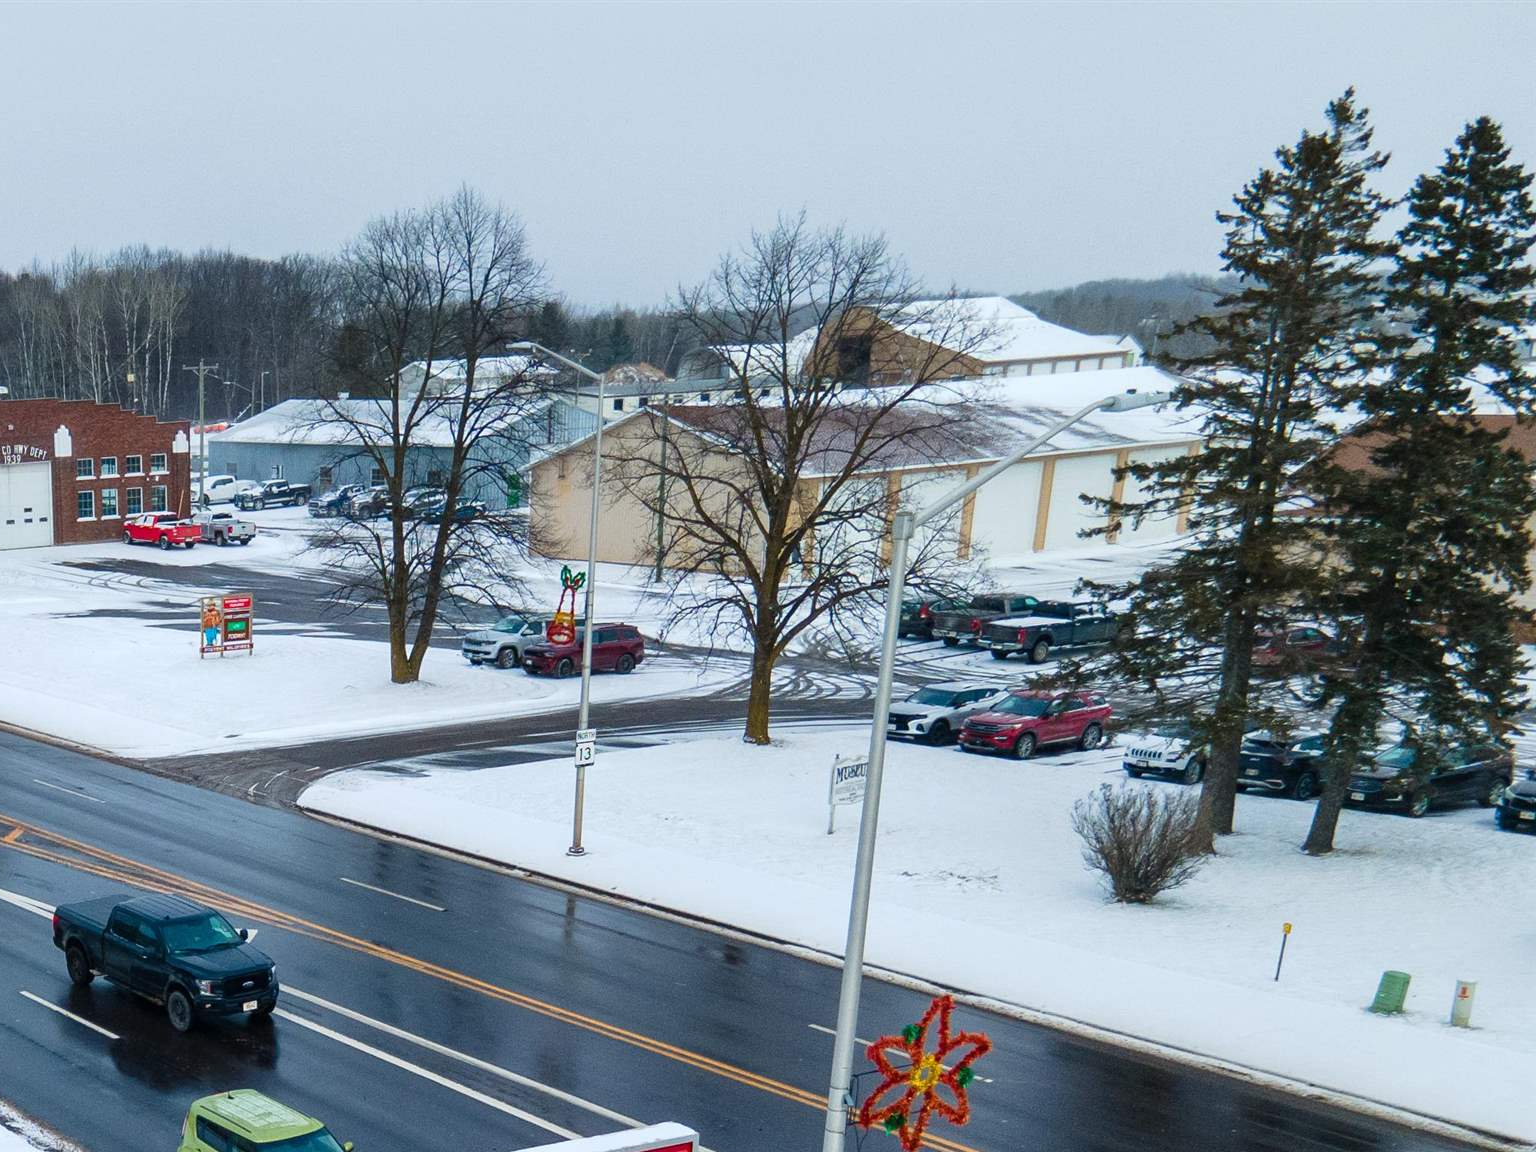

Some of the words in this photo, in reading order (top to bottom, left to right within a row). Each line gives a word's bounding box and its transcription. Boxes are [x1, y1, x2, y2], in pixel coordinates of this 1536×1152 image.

[1, 444, 12, 455] CO
[13, 444, 29, 454] HWY
[29, 446, 47, 460] DEPT
[4, 454, 21, 464] 1939
[577, 731, 595, 740] NORTH
[579, 747, 591, 761] 13
[835, 762, 869, 785] MUSEU
